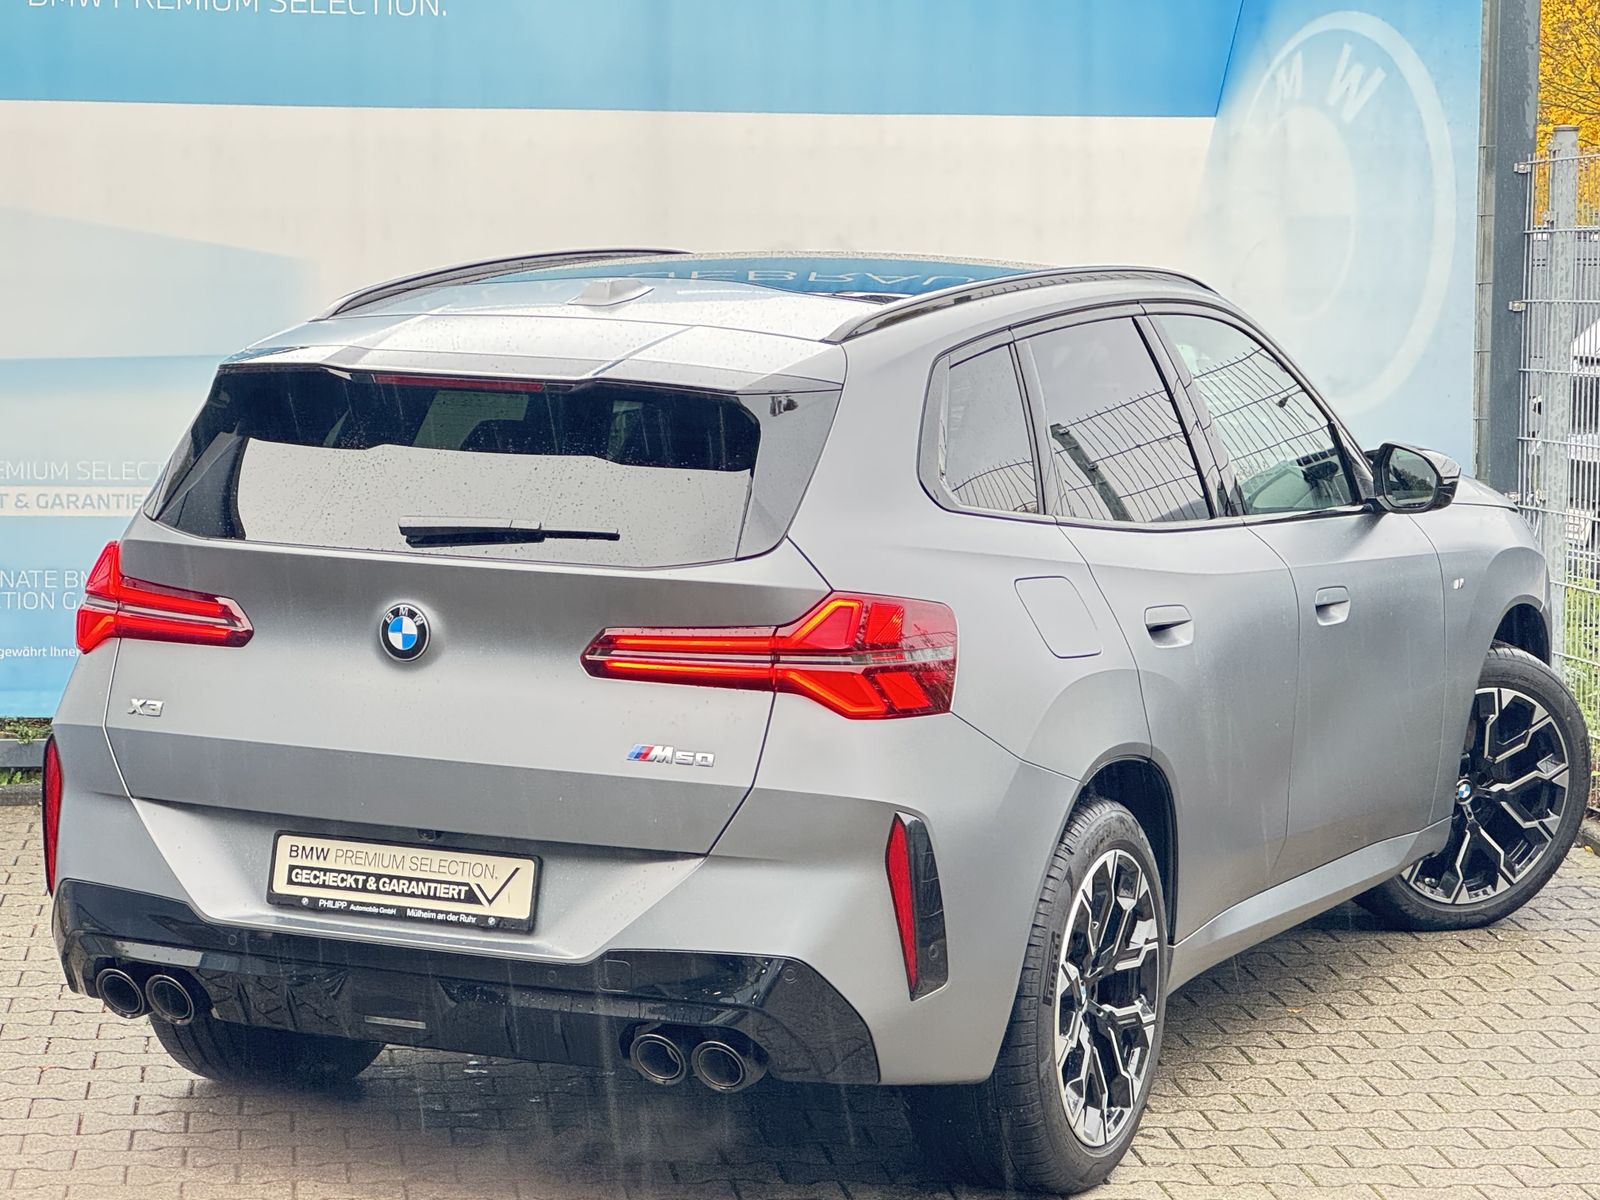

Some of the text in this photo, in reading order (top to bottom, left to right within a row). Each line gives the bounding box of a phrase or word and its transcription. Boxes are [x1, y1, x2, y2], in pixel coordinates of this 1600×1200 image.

[14, 493, 30, 509] &
[0, 591, 55, 610] TION
[50, 646, 80, 657] Ihne
[127, 698, 164, 717] X3
[646, 745, 715, 768] M50
[289, 844, 498, 879] BMW PREMIUM SELECTION.
[291, 868, 469, 900] GECHECKT & GARANTIERT
[318, 899, 477, 923] PHILIPP Automobile GmbH Mülheim an der Ruhr
